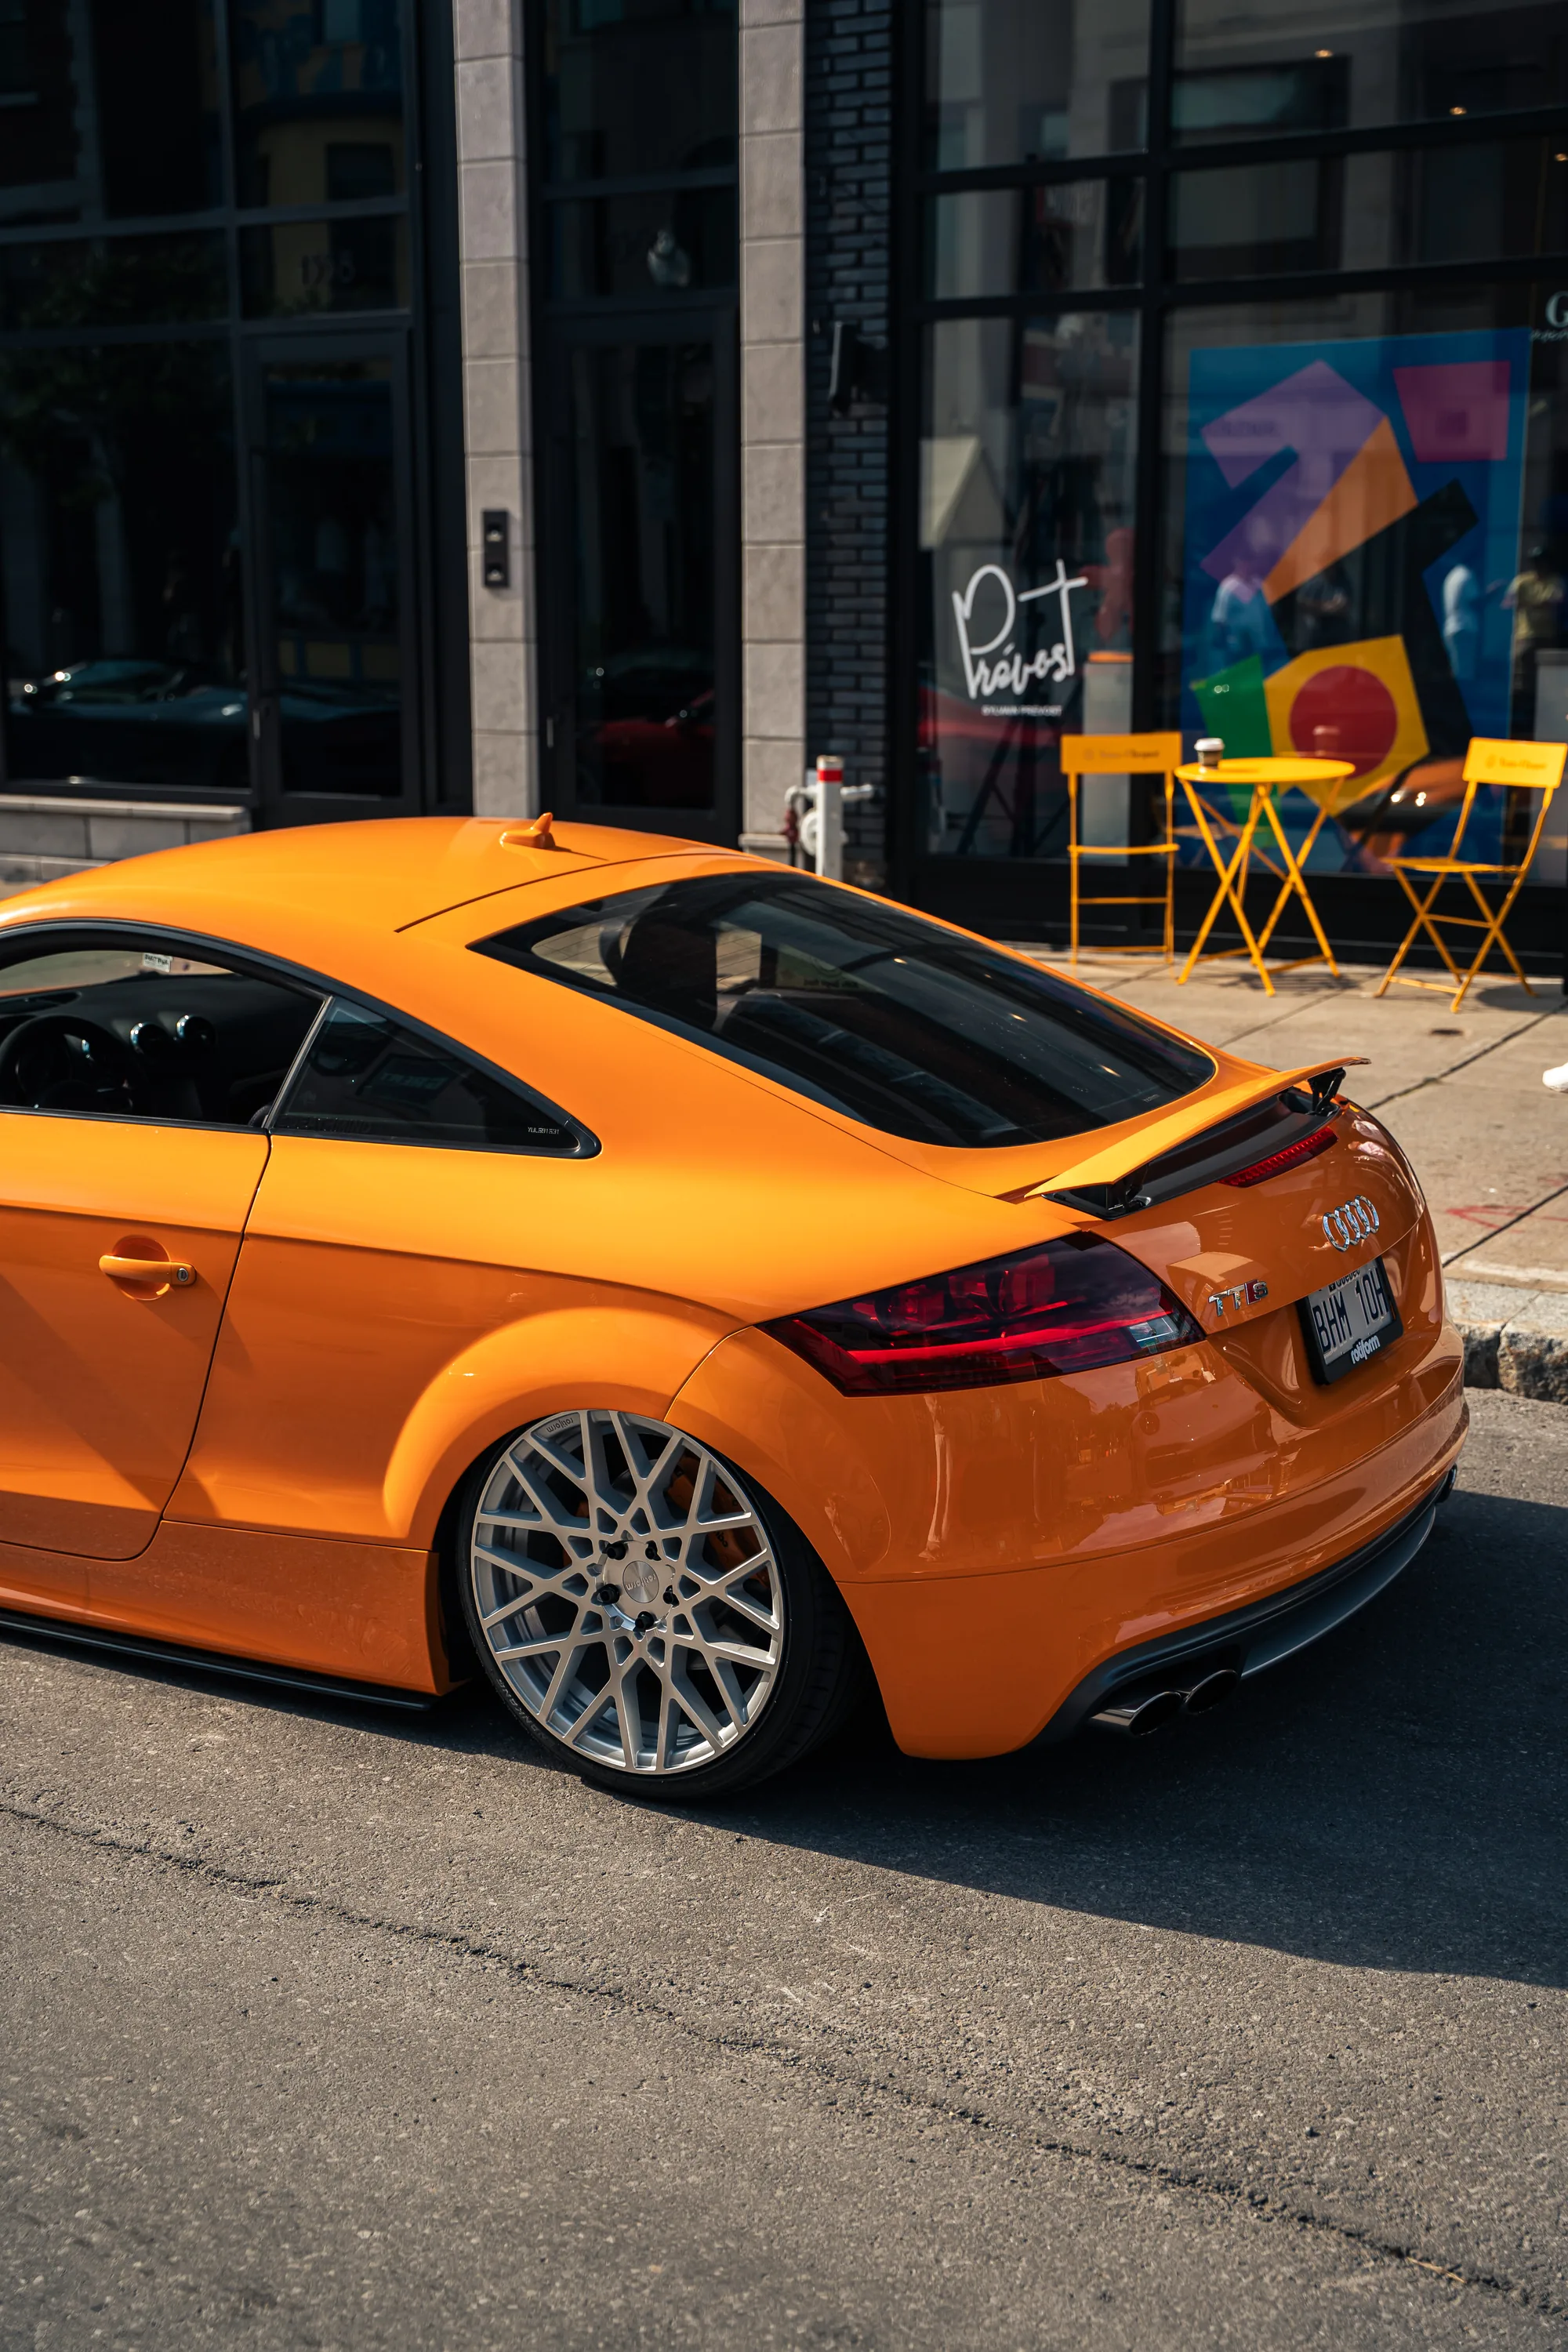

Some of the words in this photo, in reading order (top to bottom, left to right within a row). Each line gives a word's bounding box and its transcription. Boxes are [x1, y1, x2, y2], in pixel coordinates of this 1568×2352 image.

[1208, 1279, 1269, 1317] TTS
[1312, 1290, 1353, 1354] BHM
[1356, 1267, 1389, 1326] 10H
[1350, 1334, 1381, 1365] rotiform
[546, 1417, 574, 1433] rotiform
[626, 1573, 656, 1591] rotiform
